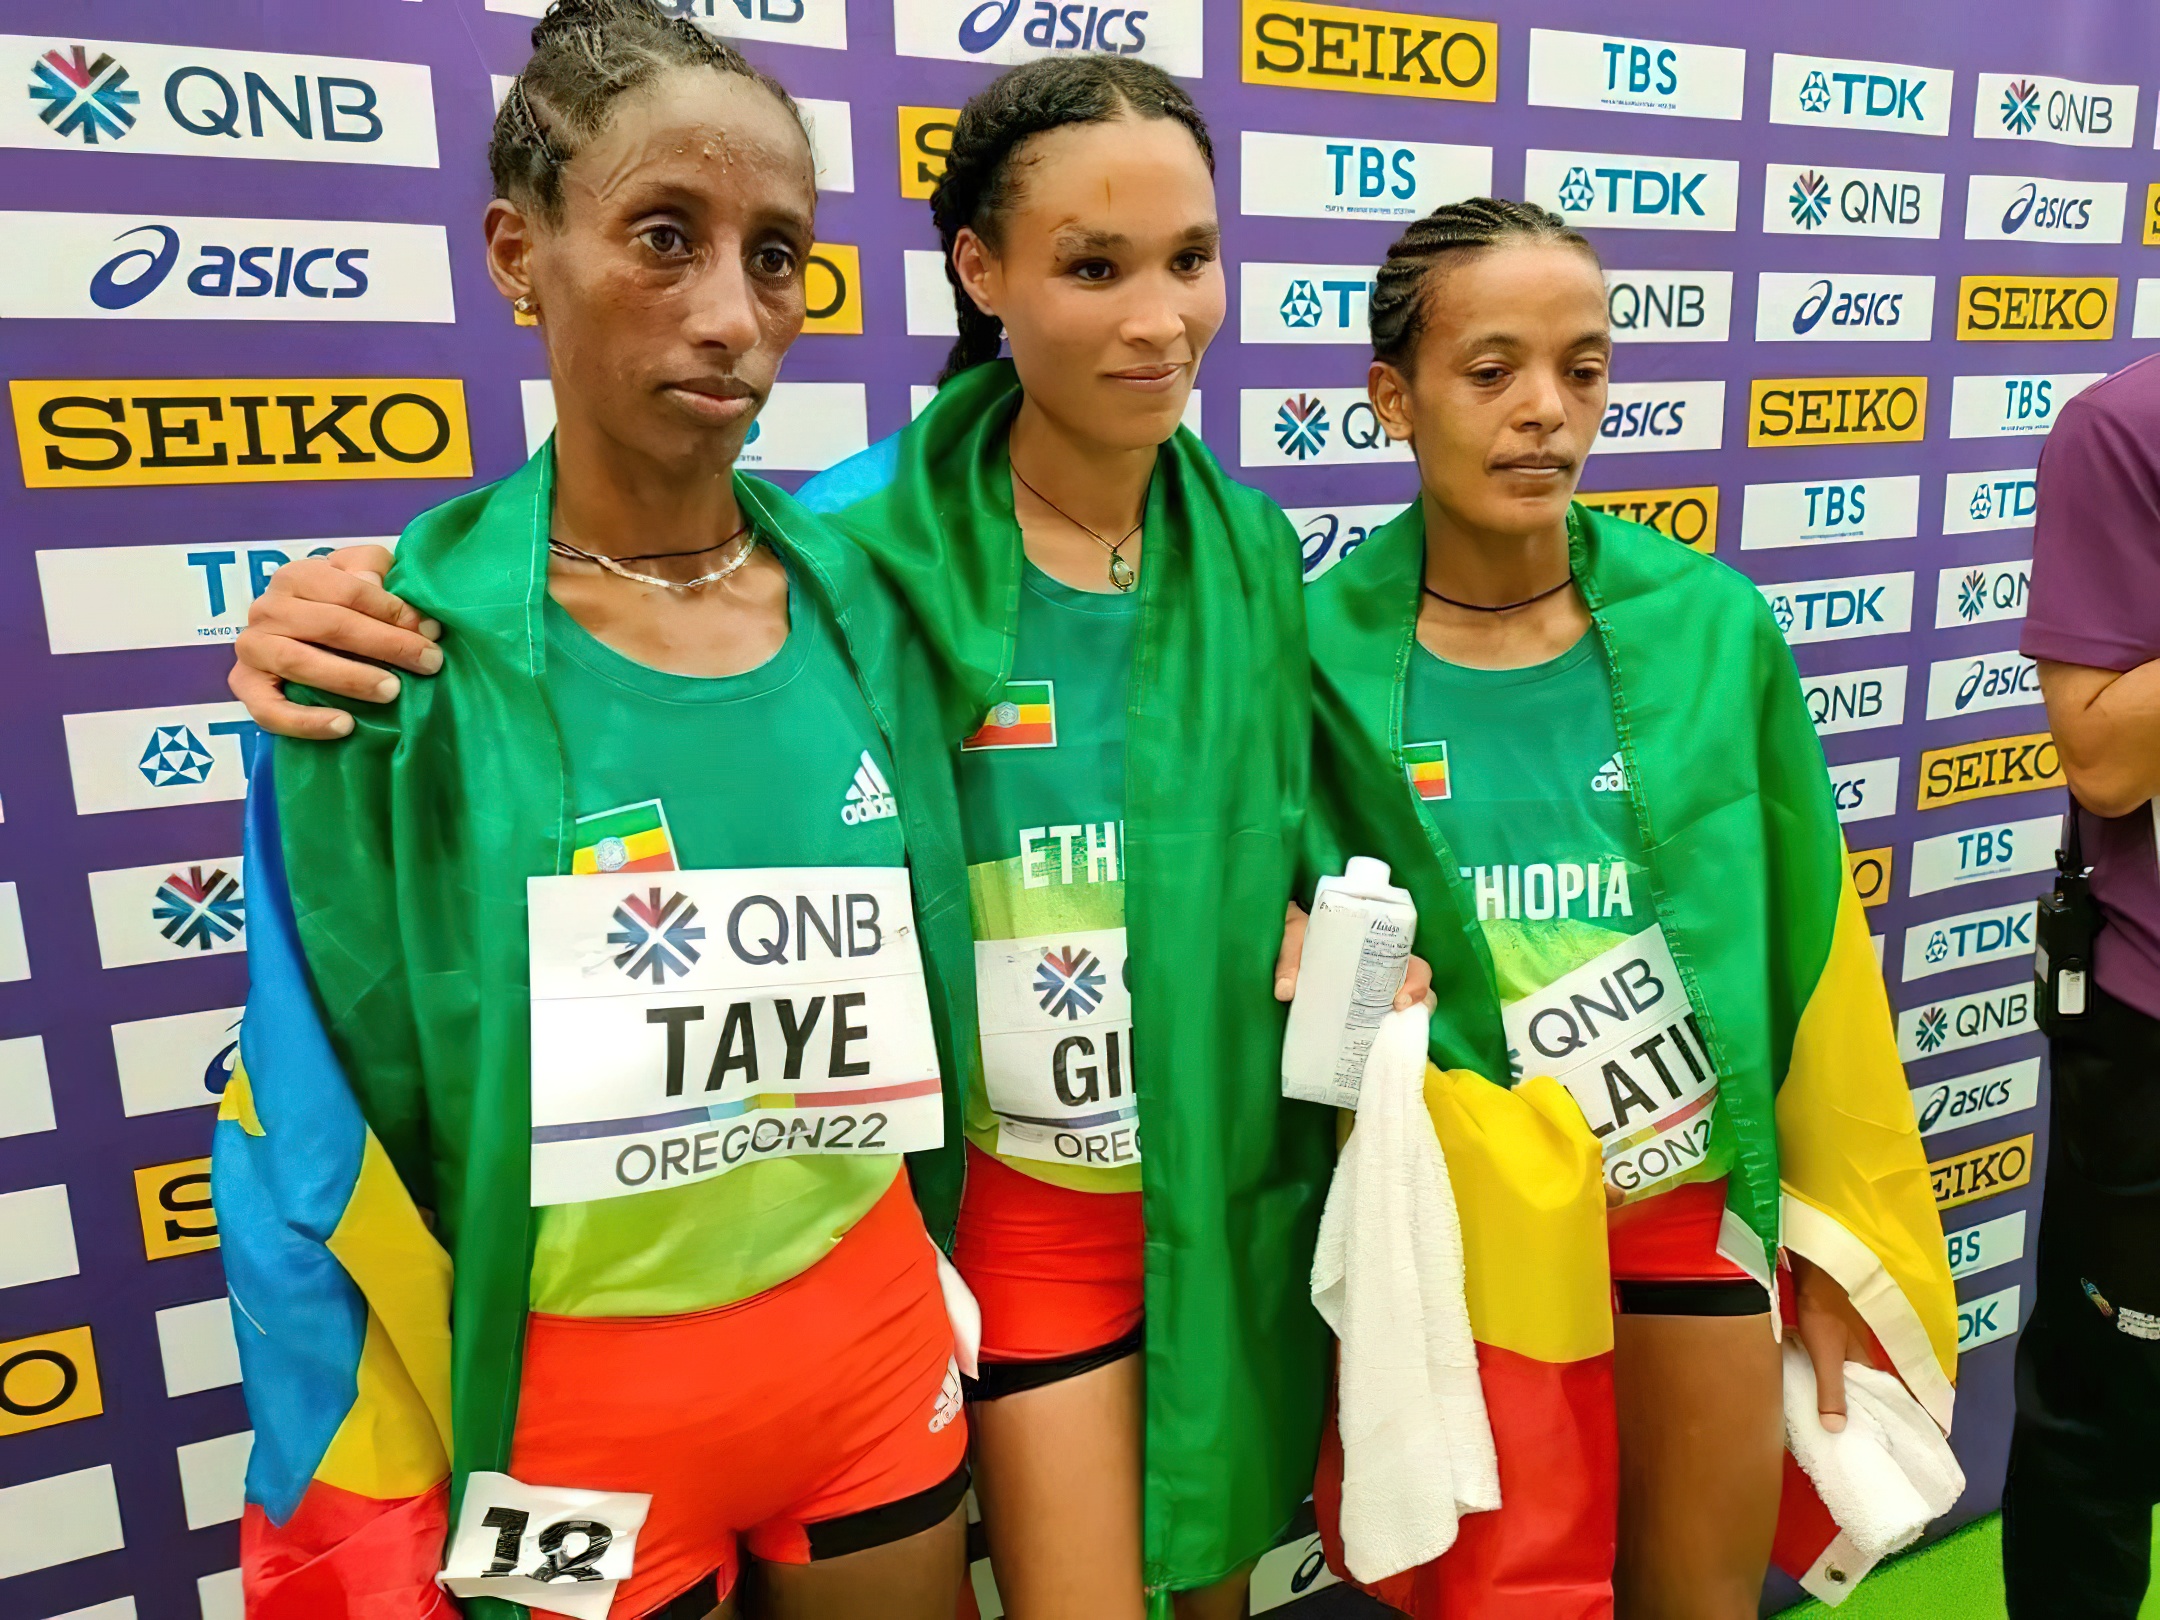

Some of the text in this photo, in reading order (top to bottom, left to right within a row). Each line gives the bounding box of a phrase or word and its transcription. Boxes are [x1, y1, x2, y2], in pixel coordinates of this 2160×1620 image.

[1023, 2, 1148, 54] asics
[1256, 13, 1486, 88] SEIKO
[1602, 42, 1677, 96] TBS
[164, 66, 383, 142] QNB
[1833, 72, 1927, 121] TDK
[2047, 90, 2112, 134] QNB
[1326, 145, 1416, 200] TBS
[1596, 168, 1707, 216] TDK
[1840, 180, 1920, 224] QNB
[2034, 197, 2093, 230] asics
[187, 246, 368, 298] asics
[1609, 283, 1704, 329] QNB
[1832, 293, 1903, 326] asics
[1968, 286, 2107, 330] SEIKO
[1600, 401, 1685, 437] asics
[1759, 387, 1917, 436] SEIKO
[2005, 380, 2052, 420] TBS
[38, 393, 450, 470] SEIKO
[1804, 484, 1866, 527] TBS
[1994, 481, 2036, 518] TD
[187, 547, 336, 617] TB
[1993, 573, 2030, 608] QN
[1795, 586, 1885, 631] TDK
[1805, 681, 1882, 724] QNB
[1983, 665, 2040, 697] asic
[1927, 741, 2061, 799] SEIKO
[1019, 820, 1125, 889] ETH
[1957, 828, 2013, 870] TBS
[1459, 861, 1633, 921] HIOPIA
[727, 894, 882, 966] QNB
[1950, 912, 2032, 957] TDK
[1529, 958, 1664, 1058] QNB
[1956, 994, 2027, 1037] QNB
[646, 992, 870, 1097] TAYE
[1053, 1031, 1136, 1106] GI
[1563, 1012, 1716, 1139] ATI
[1950, 1078, 2012, 1117] asics
[616, 1112, 887, 1187] OREGON22
[1054, 1128, 1141, 1163] ORE
[1929, 1146, 2025, 1200] EIKO
[1948, 1231, 1980, 1268] BS
[1958, 1301, 1998, 1343] DK
